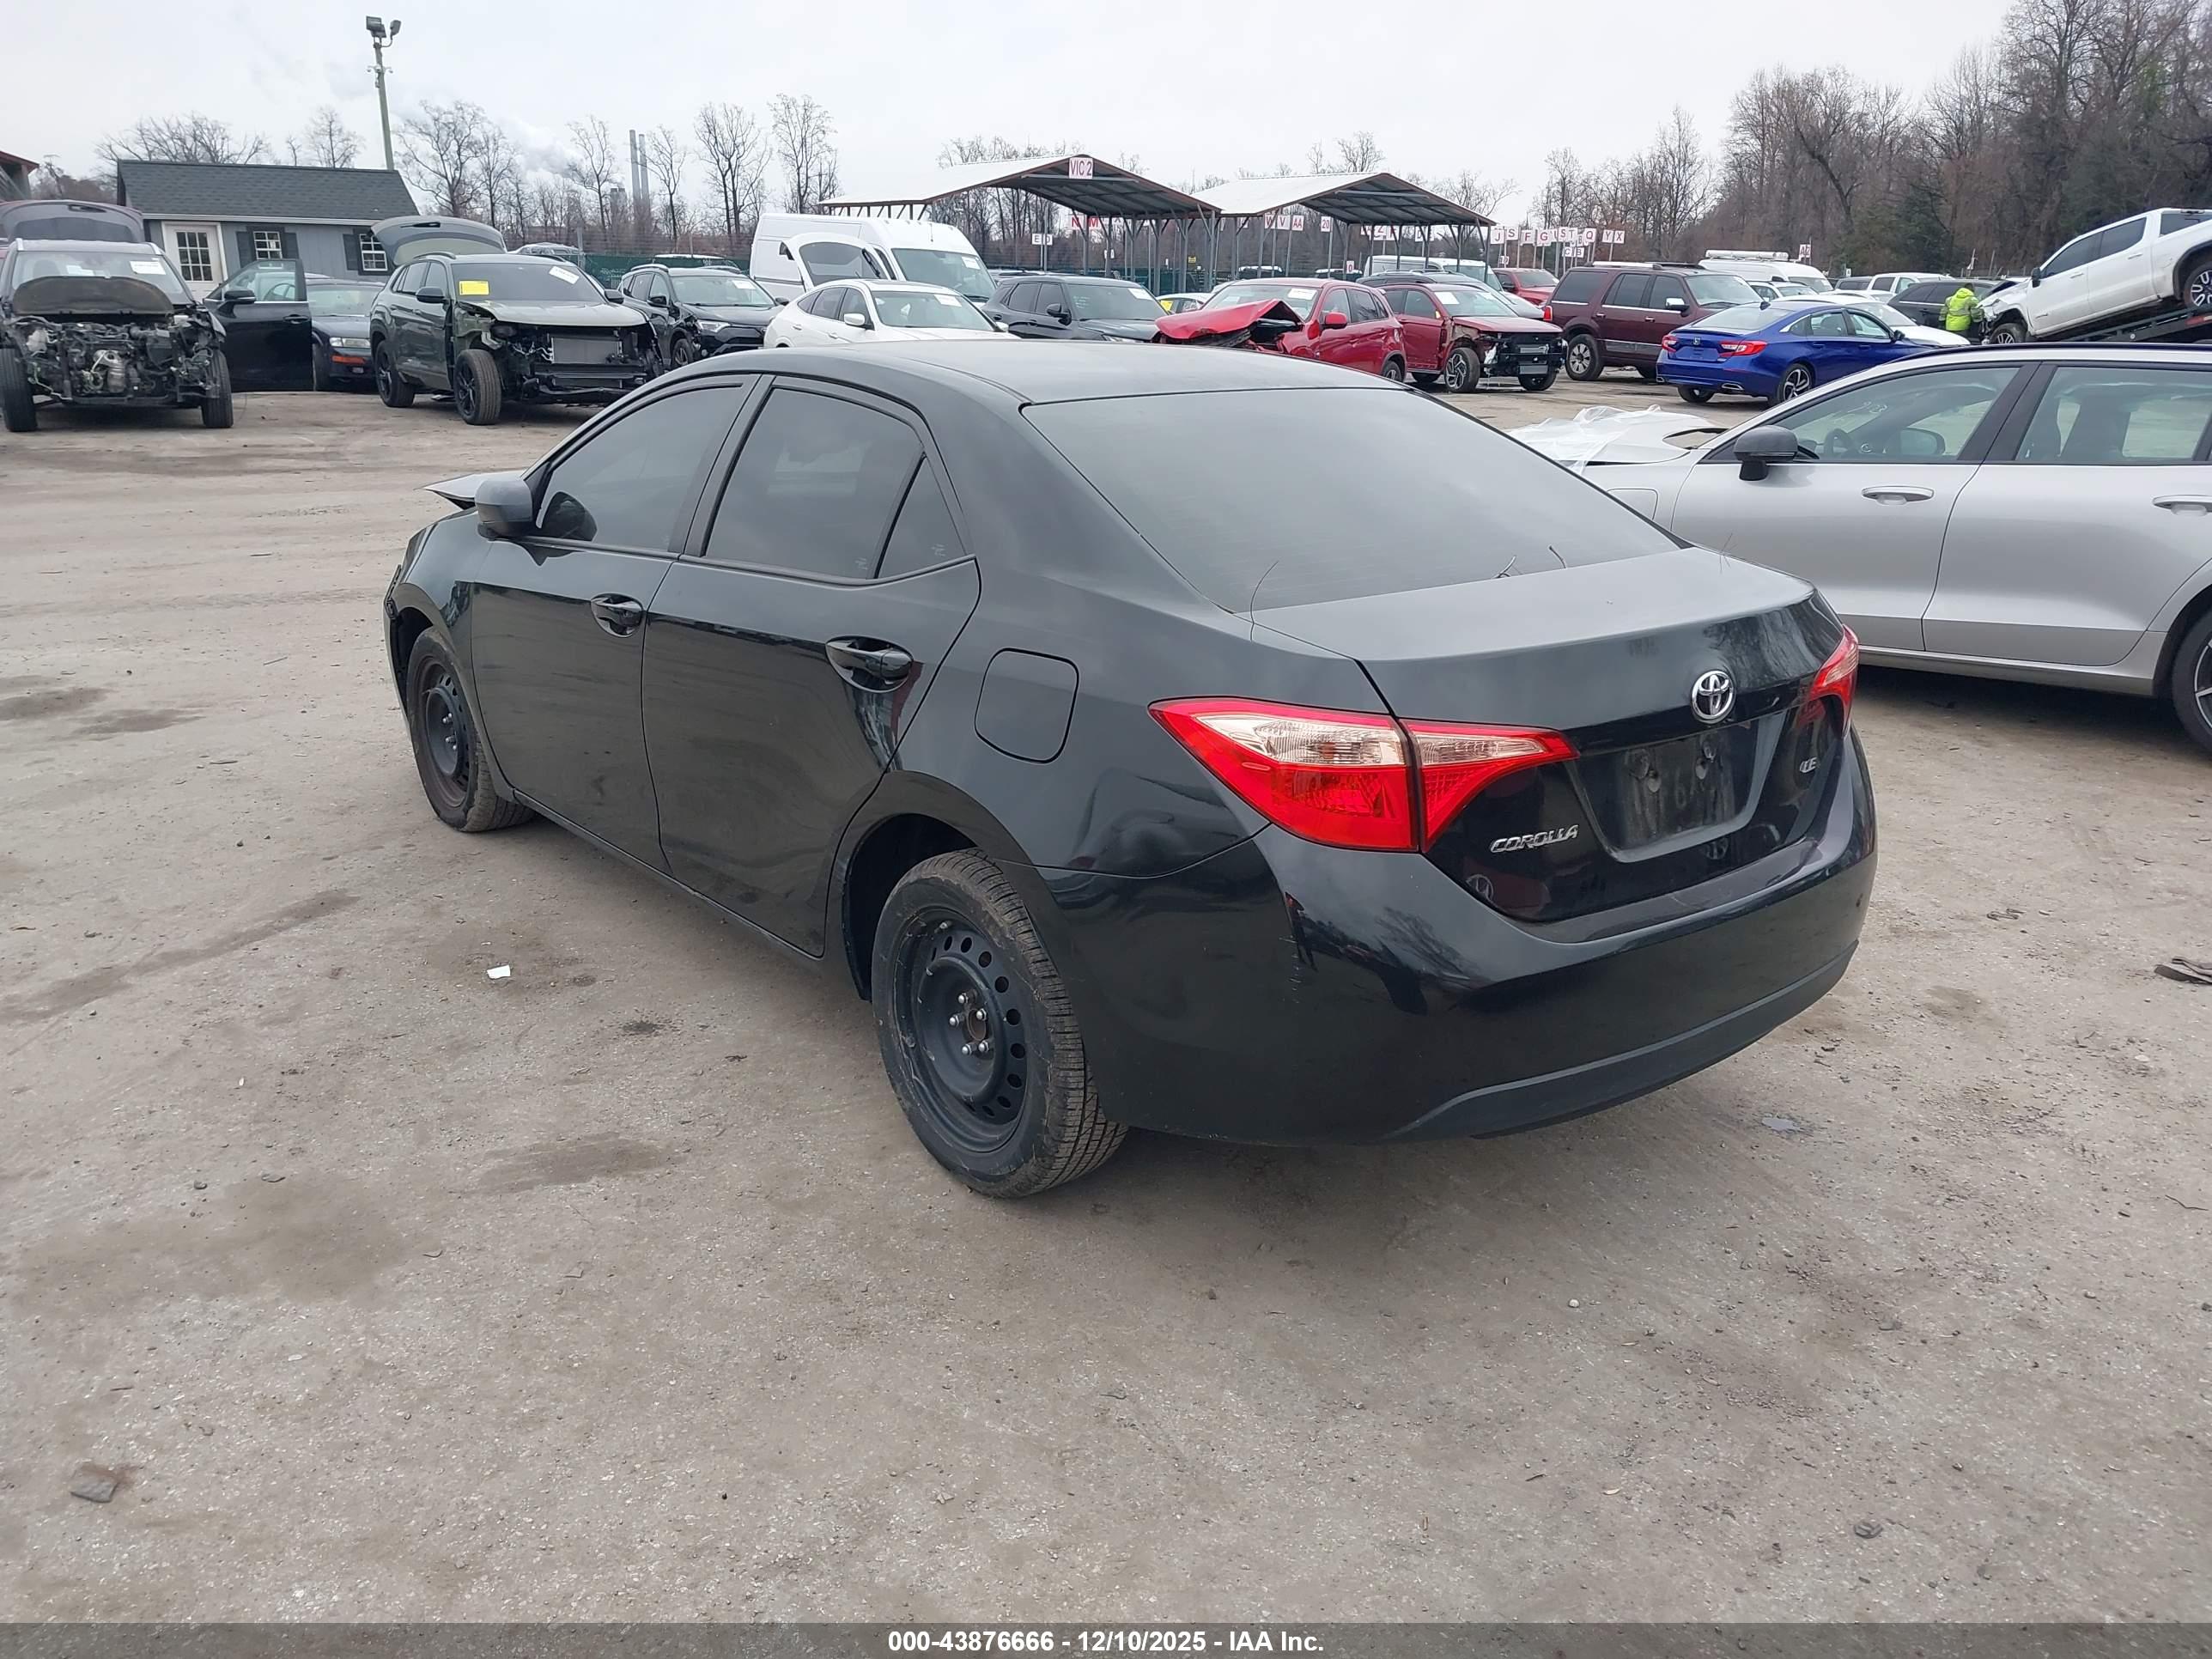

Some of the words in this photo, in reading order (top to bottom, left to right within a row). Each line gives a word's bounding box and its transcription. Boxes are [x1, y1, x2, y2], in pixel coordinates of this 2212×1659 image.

[1070, 160, 1085, 176] VIC
[1086, 161, 1092, 176] 2
[1072, 216, 1079, 228] N
[1089, 216, 1099, 228] M
[1279, 217, 1286, 227] V
[1293, 217, 1303, 228] AA
[1322, 219, 1330, 228] 20
[1495, 233, 1501, 241] J
[1508, 228, 1516, 238] S
[1525, 232, 1532, 241] F
[1540, 232, 1548, 241] G
[1560, 228, 1566, 238] S
[1568, 229, 1576, 239] T
[1585, 230, 1594, 240] Q
[1606, 231, 1613, 240] Y
[1614, 232, 1622, 241] X
[1034, 234, 1041, 243] E
[1799, 757, 1818, 774] LE
[1490, 824, 1579, 854] COROLLA
